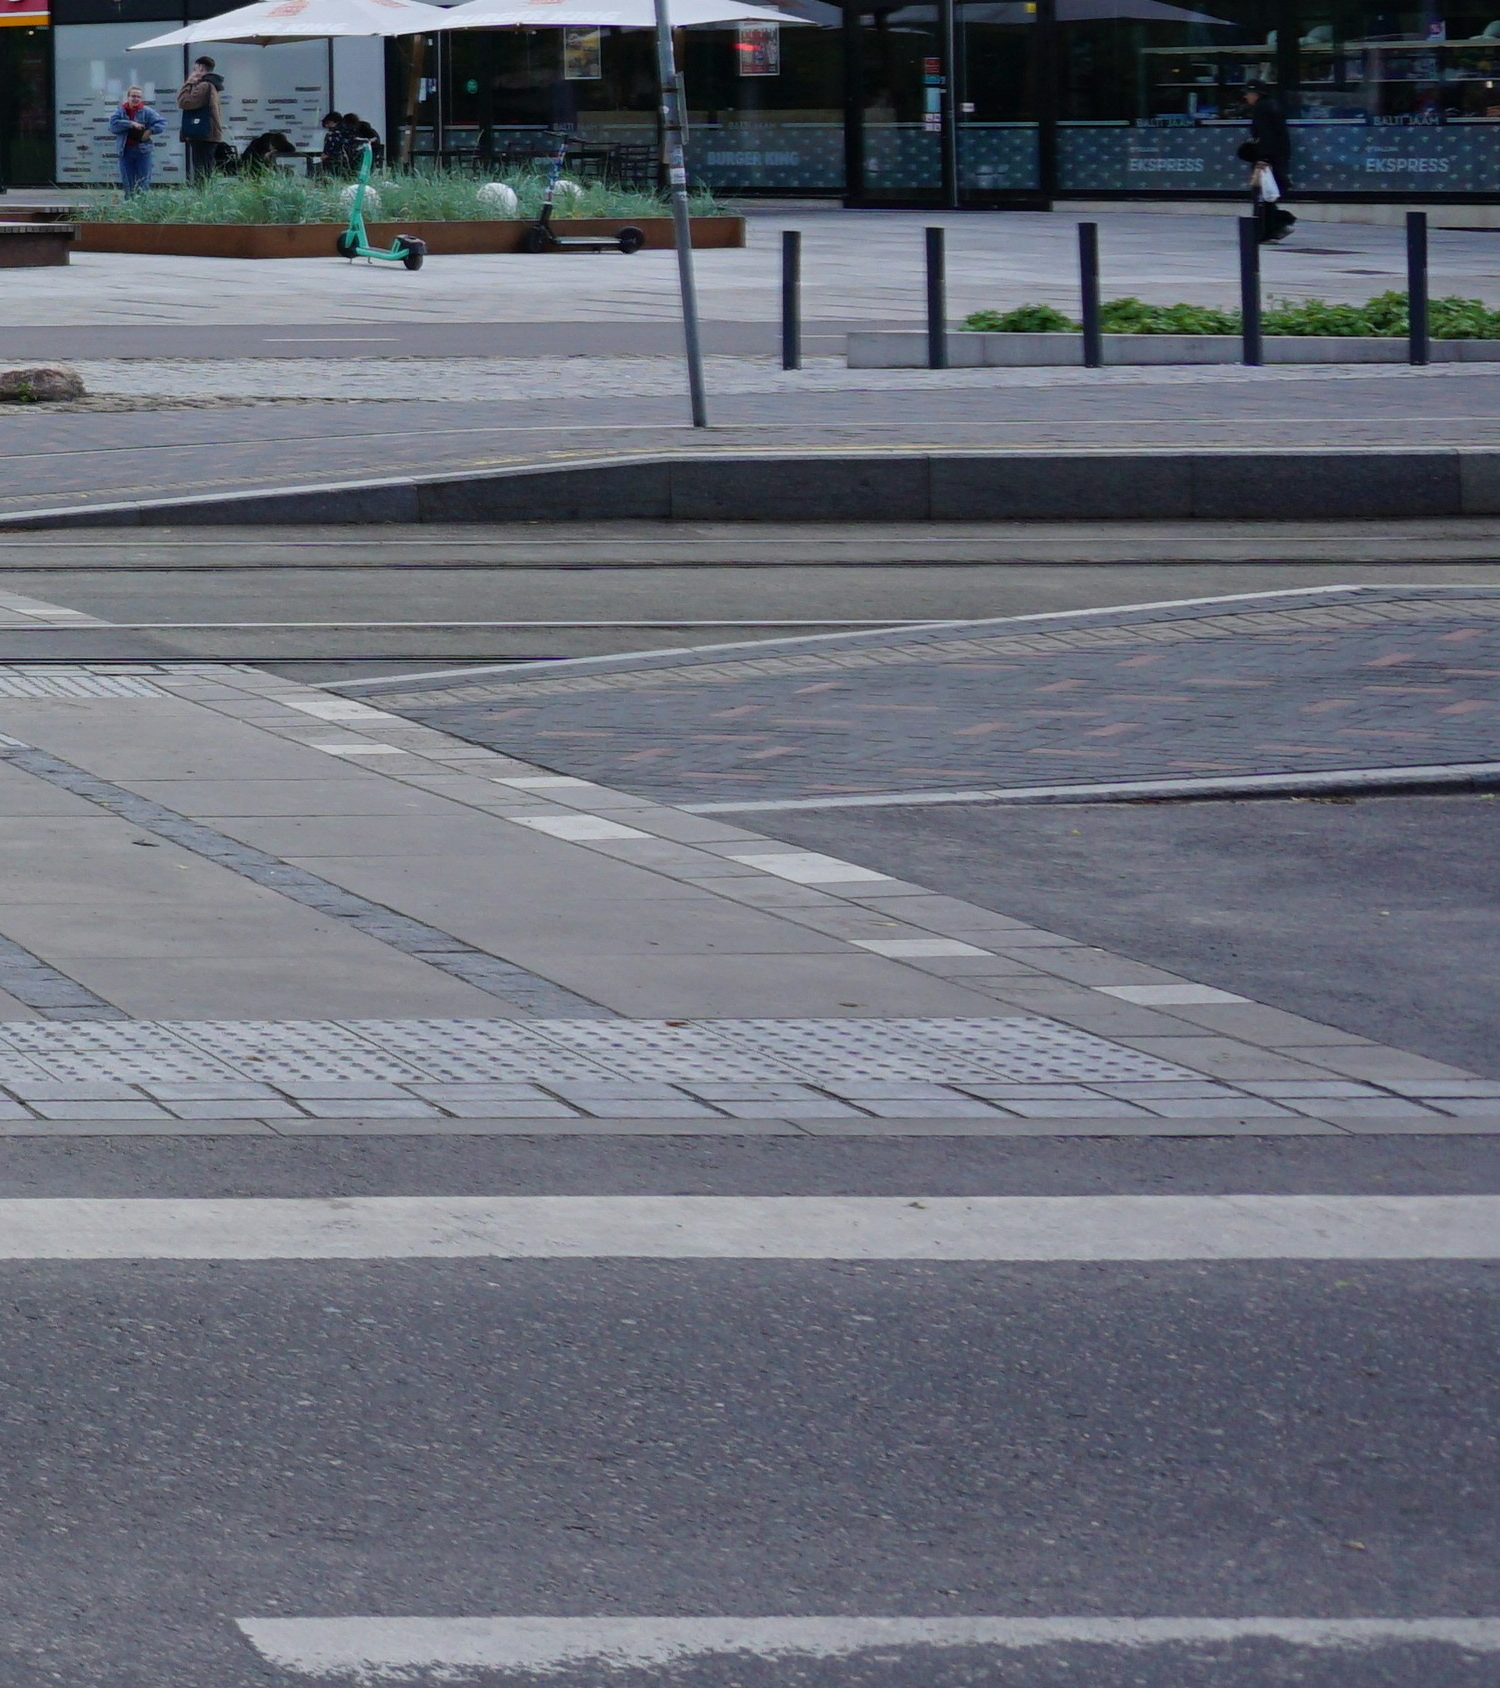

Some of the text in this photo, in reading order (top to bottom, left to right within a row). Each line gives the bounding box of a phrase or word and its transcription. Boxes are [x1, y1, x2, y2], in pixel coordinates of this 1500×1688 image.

[707, 151, 799, 166] BURGER KING
[1128, 158, 1204, 172] EKSPRESS
[1365, 158, 1449, 172] EKSPRESS
